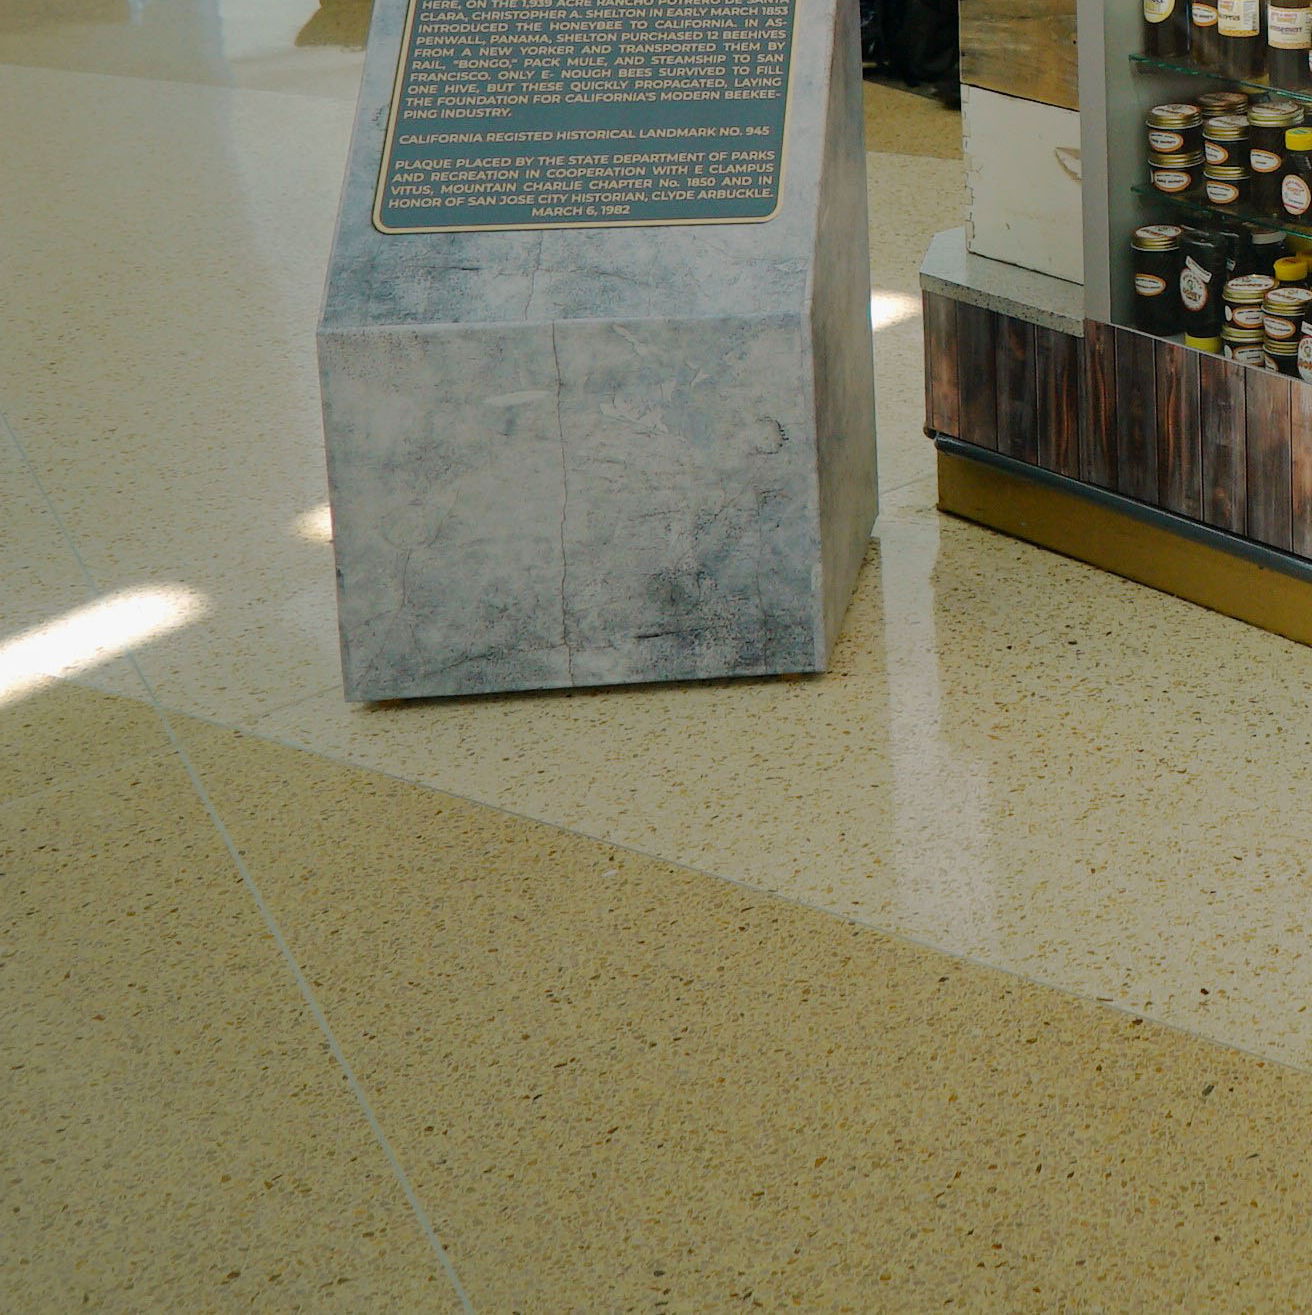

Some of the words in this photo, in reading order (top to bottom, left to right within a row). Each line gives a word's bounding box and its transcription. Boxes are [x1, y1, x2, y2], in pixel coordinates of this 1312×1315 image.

[465, 0, 487, 9] ON
[471, 9, 567, 21] CHRISTOPHER
[584, 8, 646, 19] SHELTON
[648, 7, 664, 17] IN
[665, 6, 709, 17] EARLY
[710, 6, 759, 17] MARCH
[761, 5, 789, 16] 1853
[418, 22, 509, 33] INTRODUCED
[515, 21, 542, 32] THE
[549, 20, 623, 31] HONEYBEE
[629, 20, 648, 30] TO
[744, 18, 759, 28] IN
[403, 108, 438, 119] PING
[399, 133, 483, 145] CALIFORNIA
[485, 131, 554, 142] REGISTED
[555, 129, 636, 140] HISTORICAL
[638, 126, 716, 138] LANDMARK
[745, 125, 770, 136] 945
[394, 158, 452, 171] PLAQUE
[455, 157, 512, 168] PLACED
[514, 155, 535, 167] BY
[537, 155, 565, 166] THE
[567, 154, 610, 165] STATE
[612, 151, 706, 164] DEPARTMENT
[708, 151, 728, 162] OF
[730, 150, 776, 161] PARKS
[440, 182, 517, 194] MOUNTAIN
[522, 180, 583, 192] CHARLIE
[588, 178, 653, 190] CHAPTER
[686, 176, 716, 187] 1850
[720, 175, 753, 186] AND
[758, 175, 773, 185] IN
[388, 197, 442, 208] HONOR
[444, 196, 465, 207] OF
[467, 195, 497, 206] SAN
[498, 194, 535, 205] JOSE
[537, 193, 569, 204] CITY
[651, 189, 695, 201] CLYDE
[531, 205, 583, 217] MARCH
[600, 204, 631, 215] 1982
